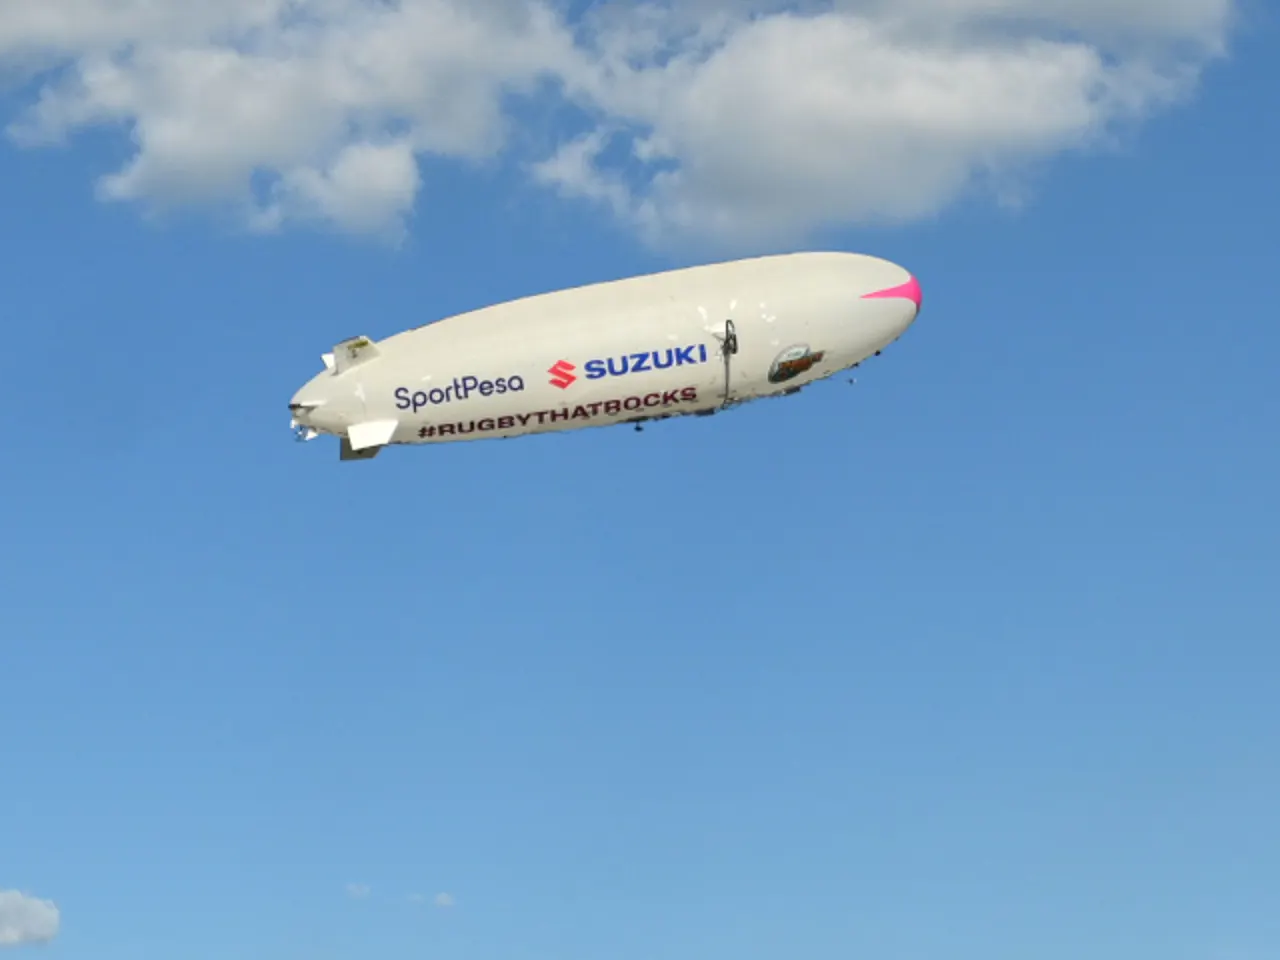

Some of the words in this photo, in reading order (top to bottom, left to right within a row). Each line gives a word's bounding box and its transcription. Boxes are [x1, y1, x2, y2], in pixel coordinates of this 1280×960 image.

[584, 344, 708, 380] SUZUKI
[394, 375, 525, 413] SportPesa
[418, 387, 698, 438] #RUGBYTHATROCKS
